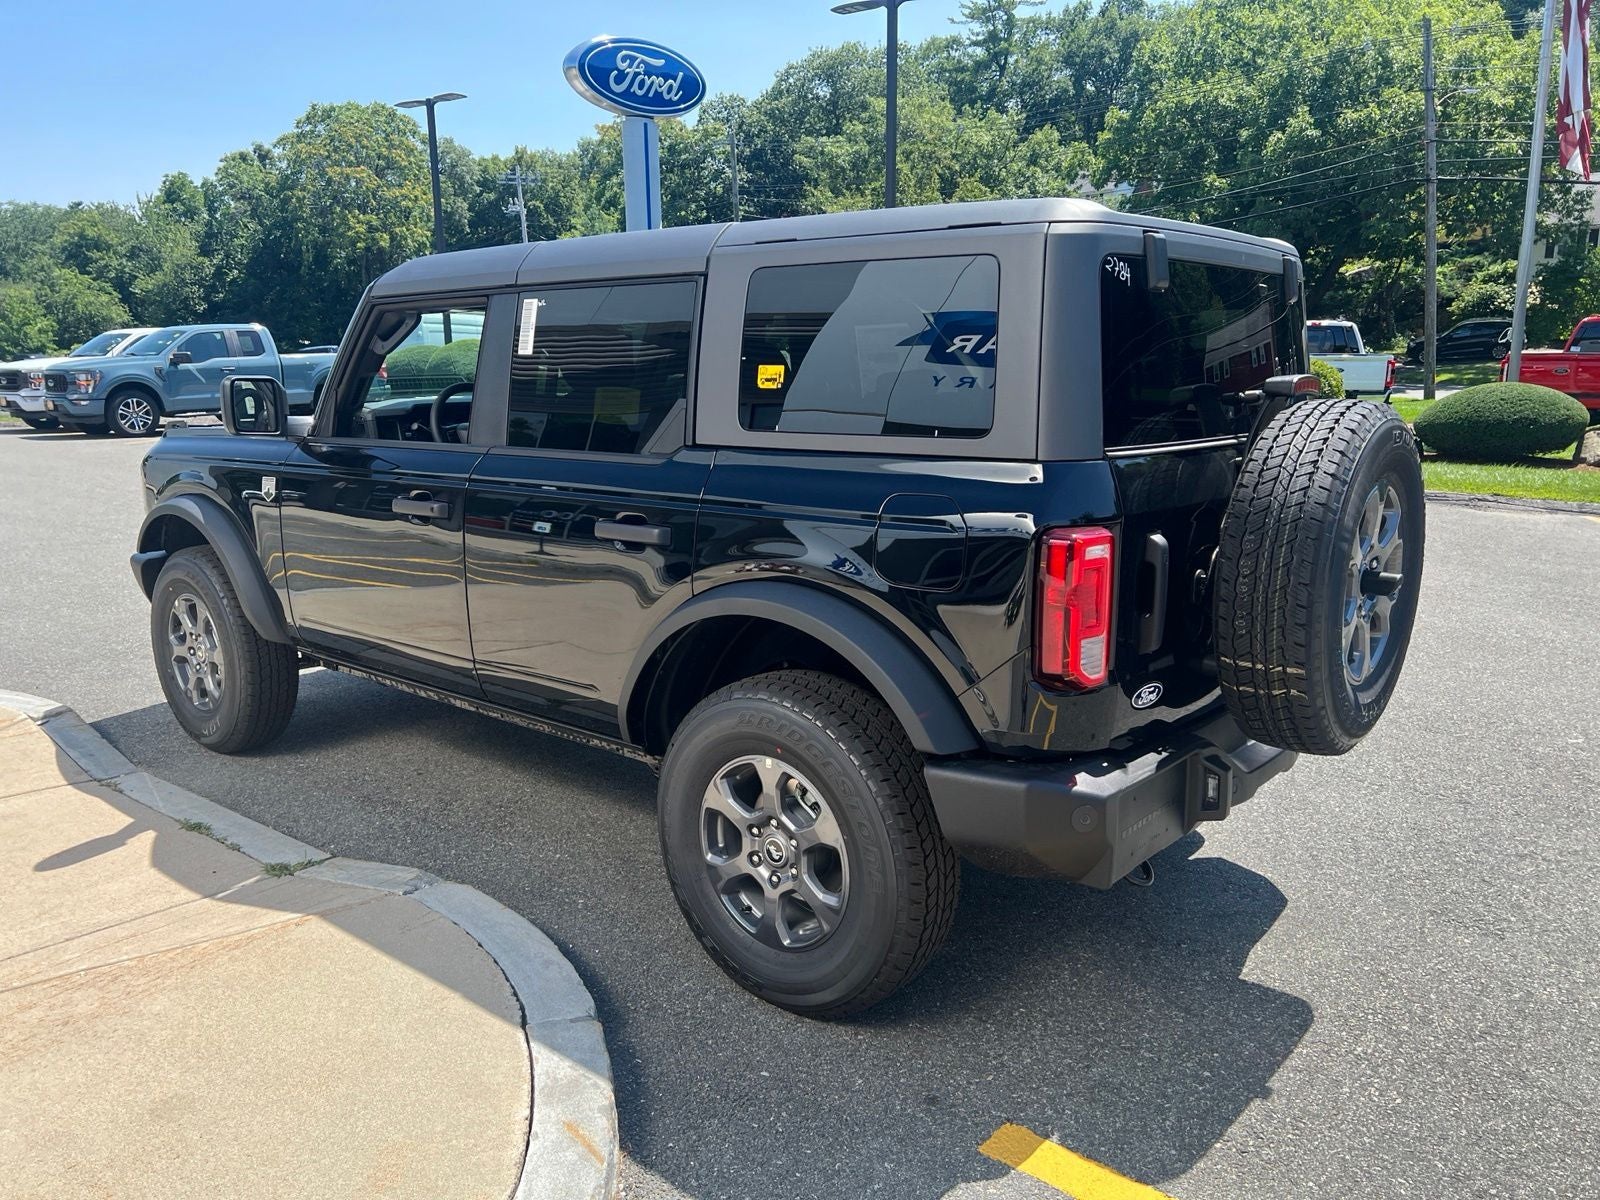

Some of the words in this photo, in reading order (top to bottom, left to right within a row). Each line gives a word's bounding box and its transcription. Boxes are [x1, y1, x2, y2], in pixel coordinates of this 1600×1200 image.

[609, 50, 683, 101] Ford
[1105, 256, 1131, 287] 2784
[1138, 686, 1159, 705] Ford
[733, 711, 885, 896] BRIDGESTONE
